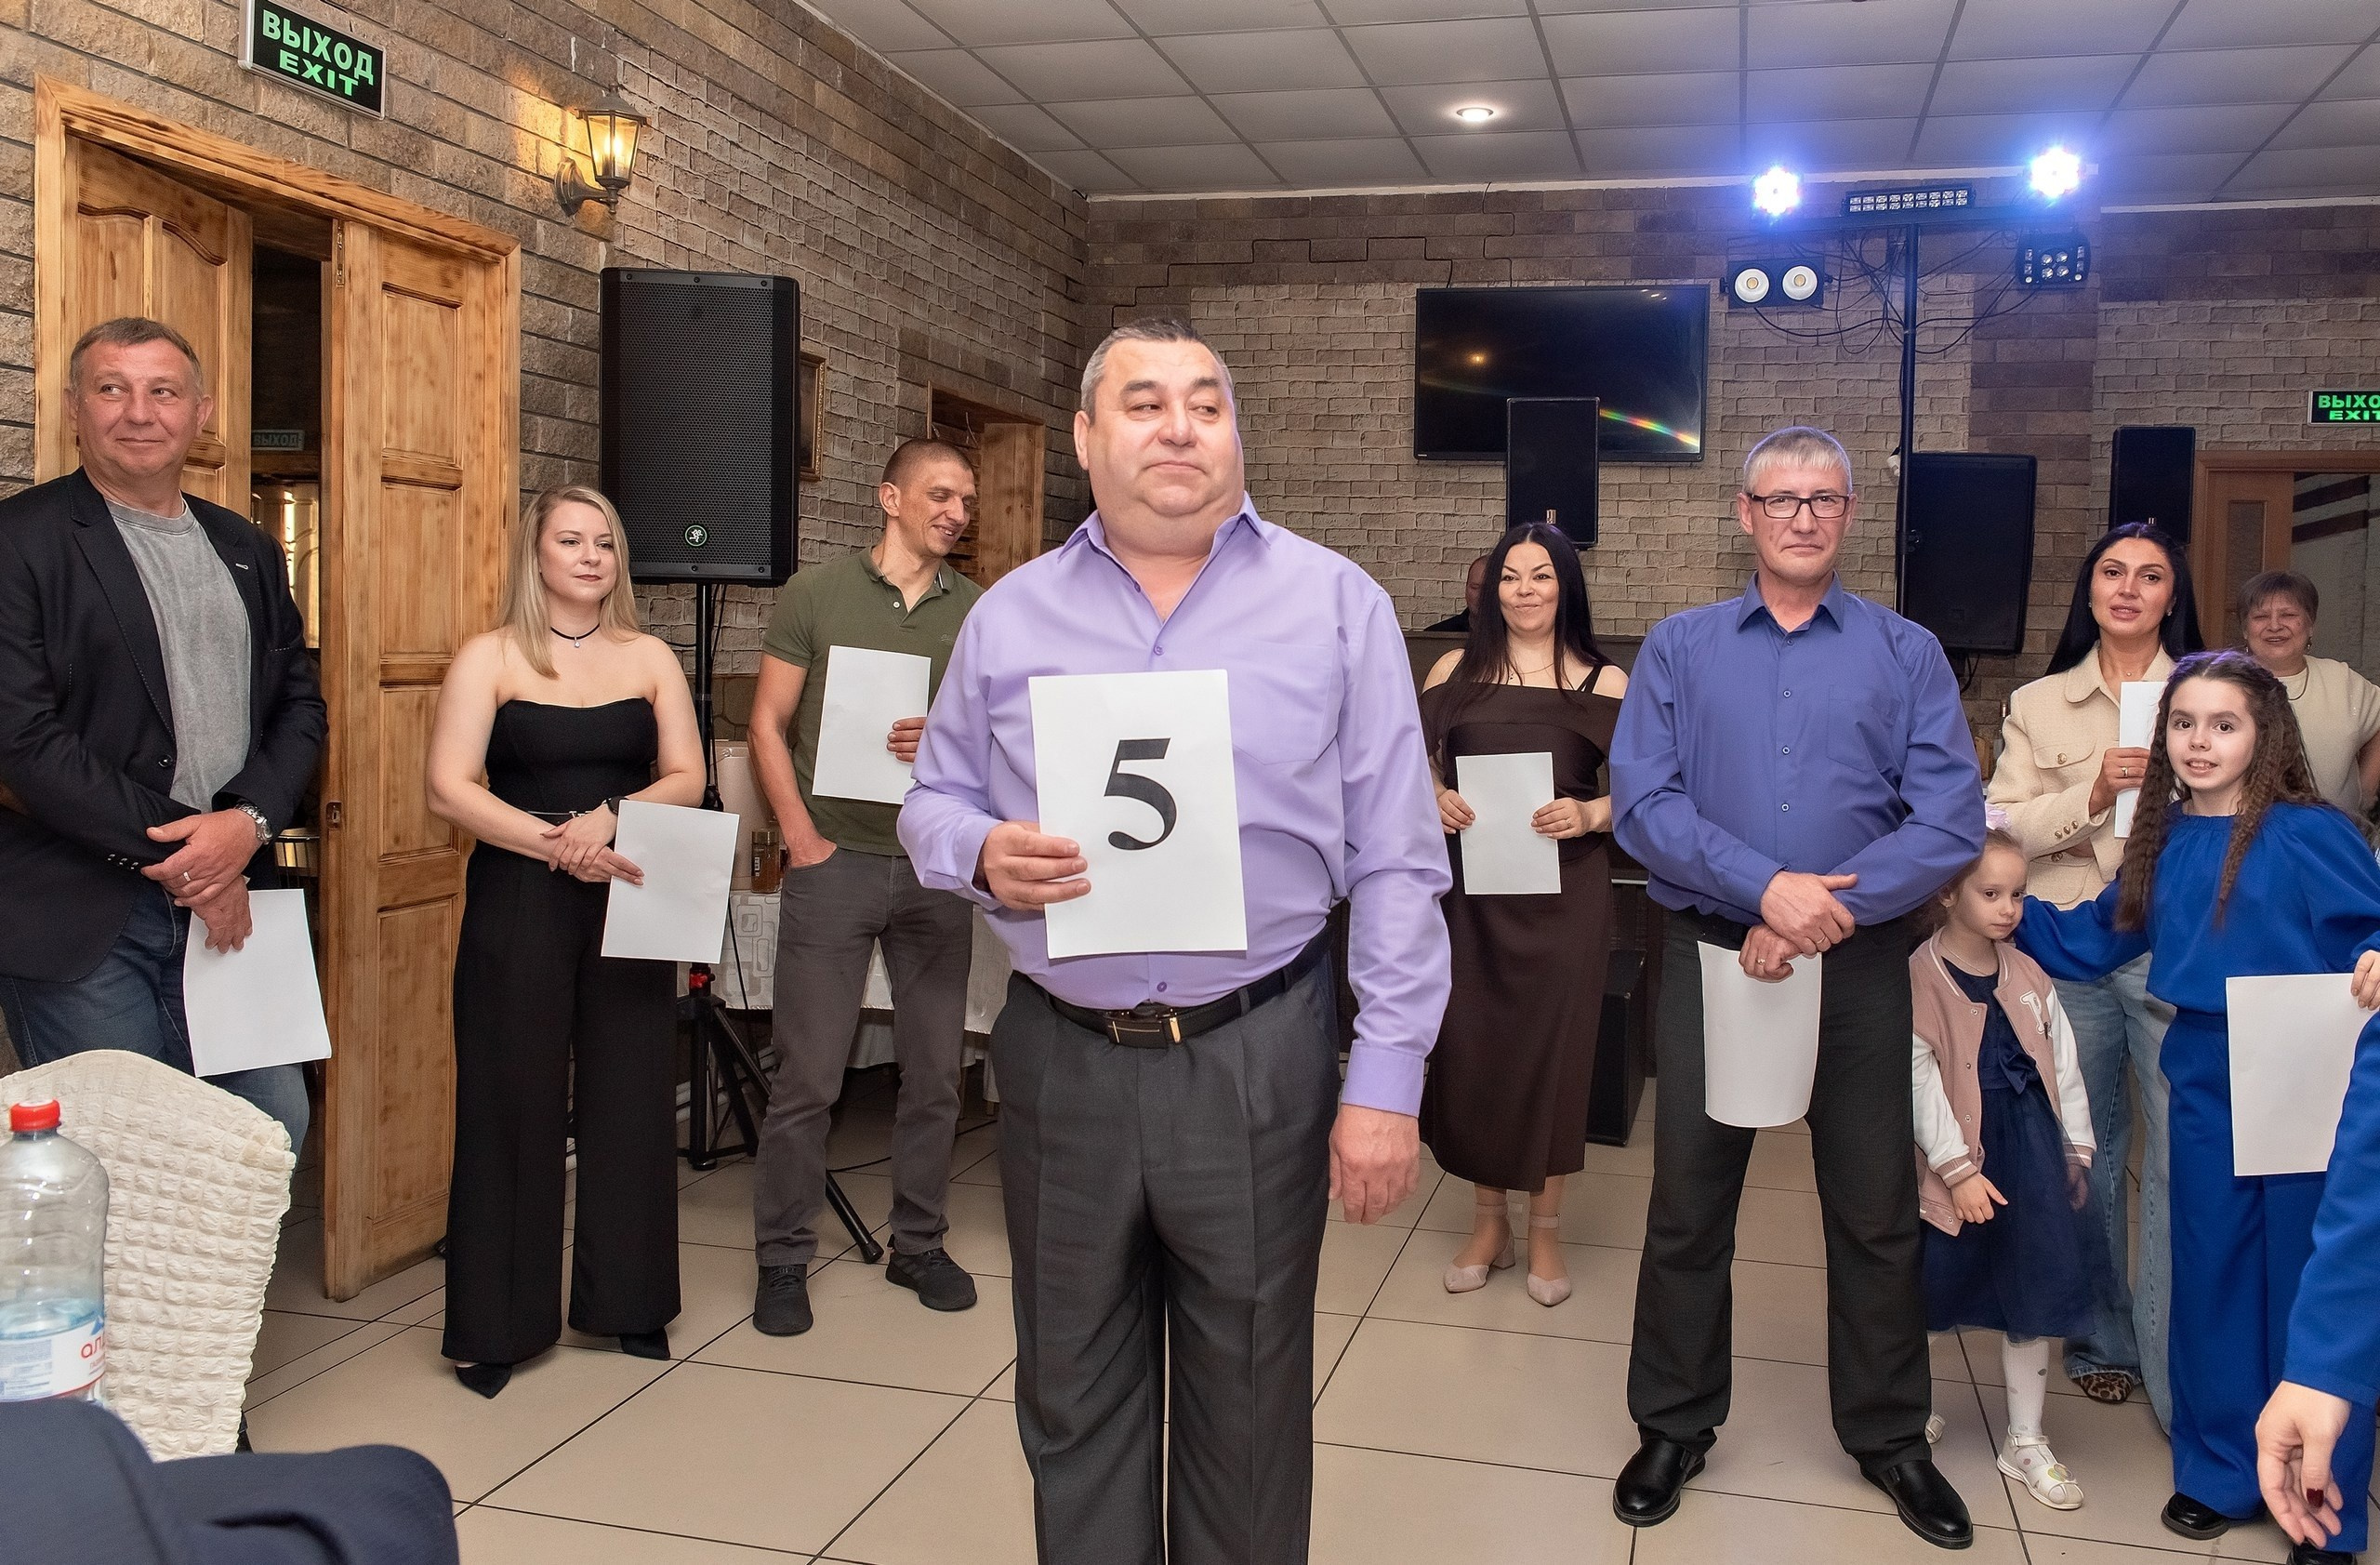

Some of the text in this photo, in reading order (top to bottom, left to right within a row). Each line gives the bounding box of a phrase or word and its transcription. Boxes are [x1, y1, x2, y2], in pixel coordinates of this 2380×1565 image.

[262, 9, 374, 86] ВЫХОД
[279, 48, 359, 96] EXIT
[1104, 737, 1177, 851] 5
